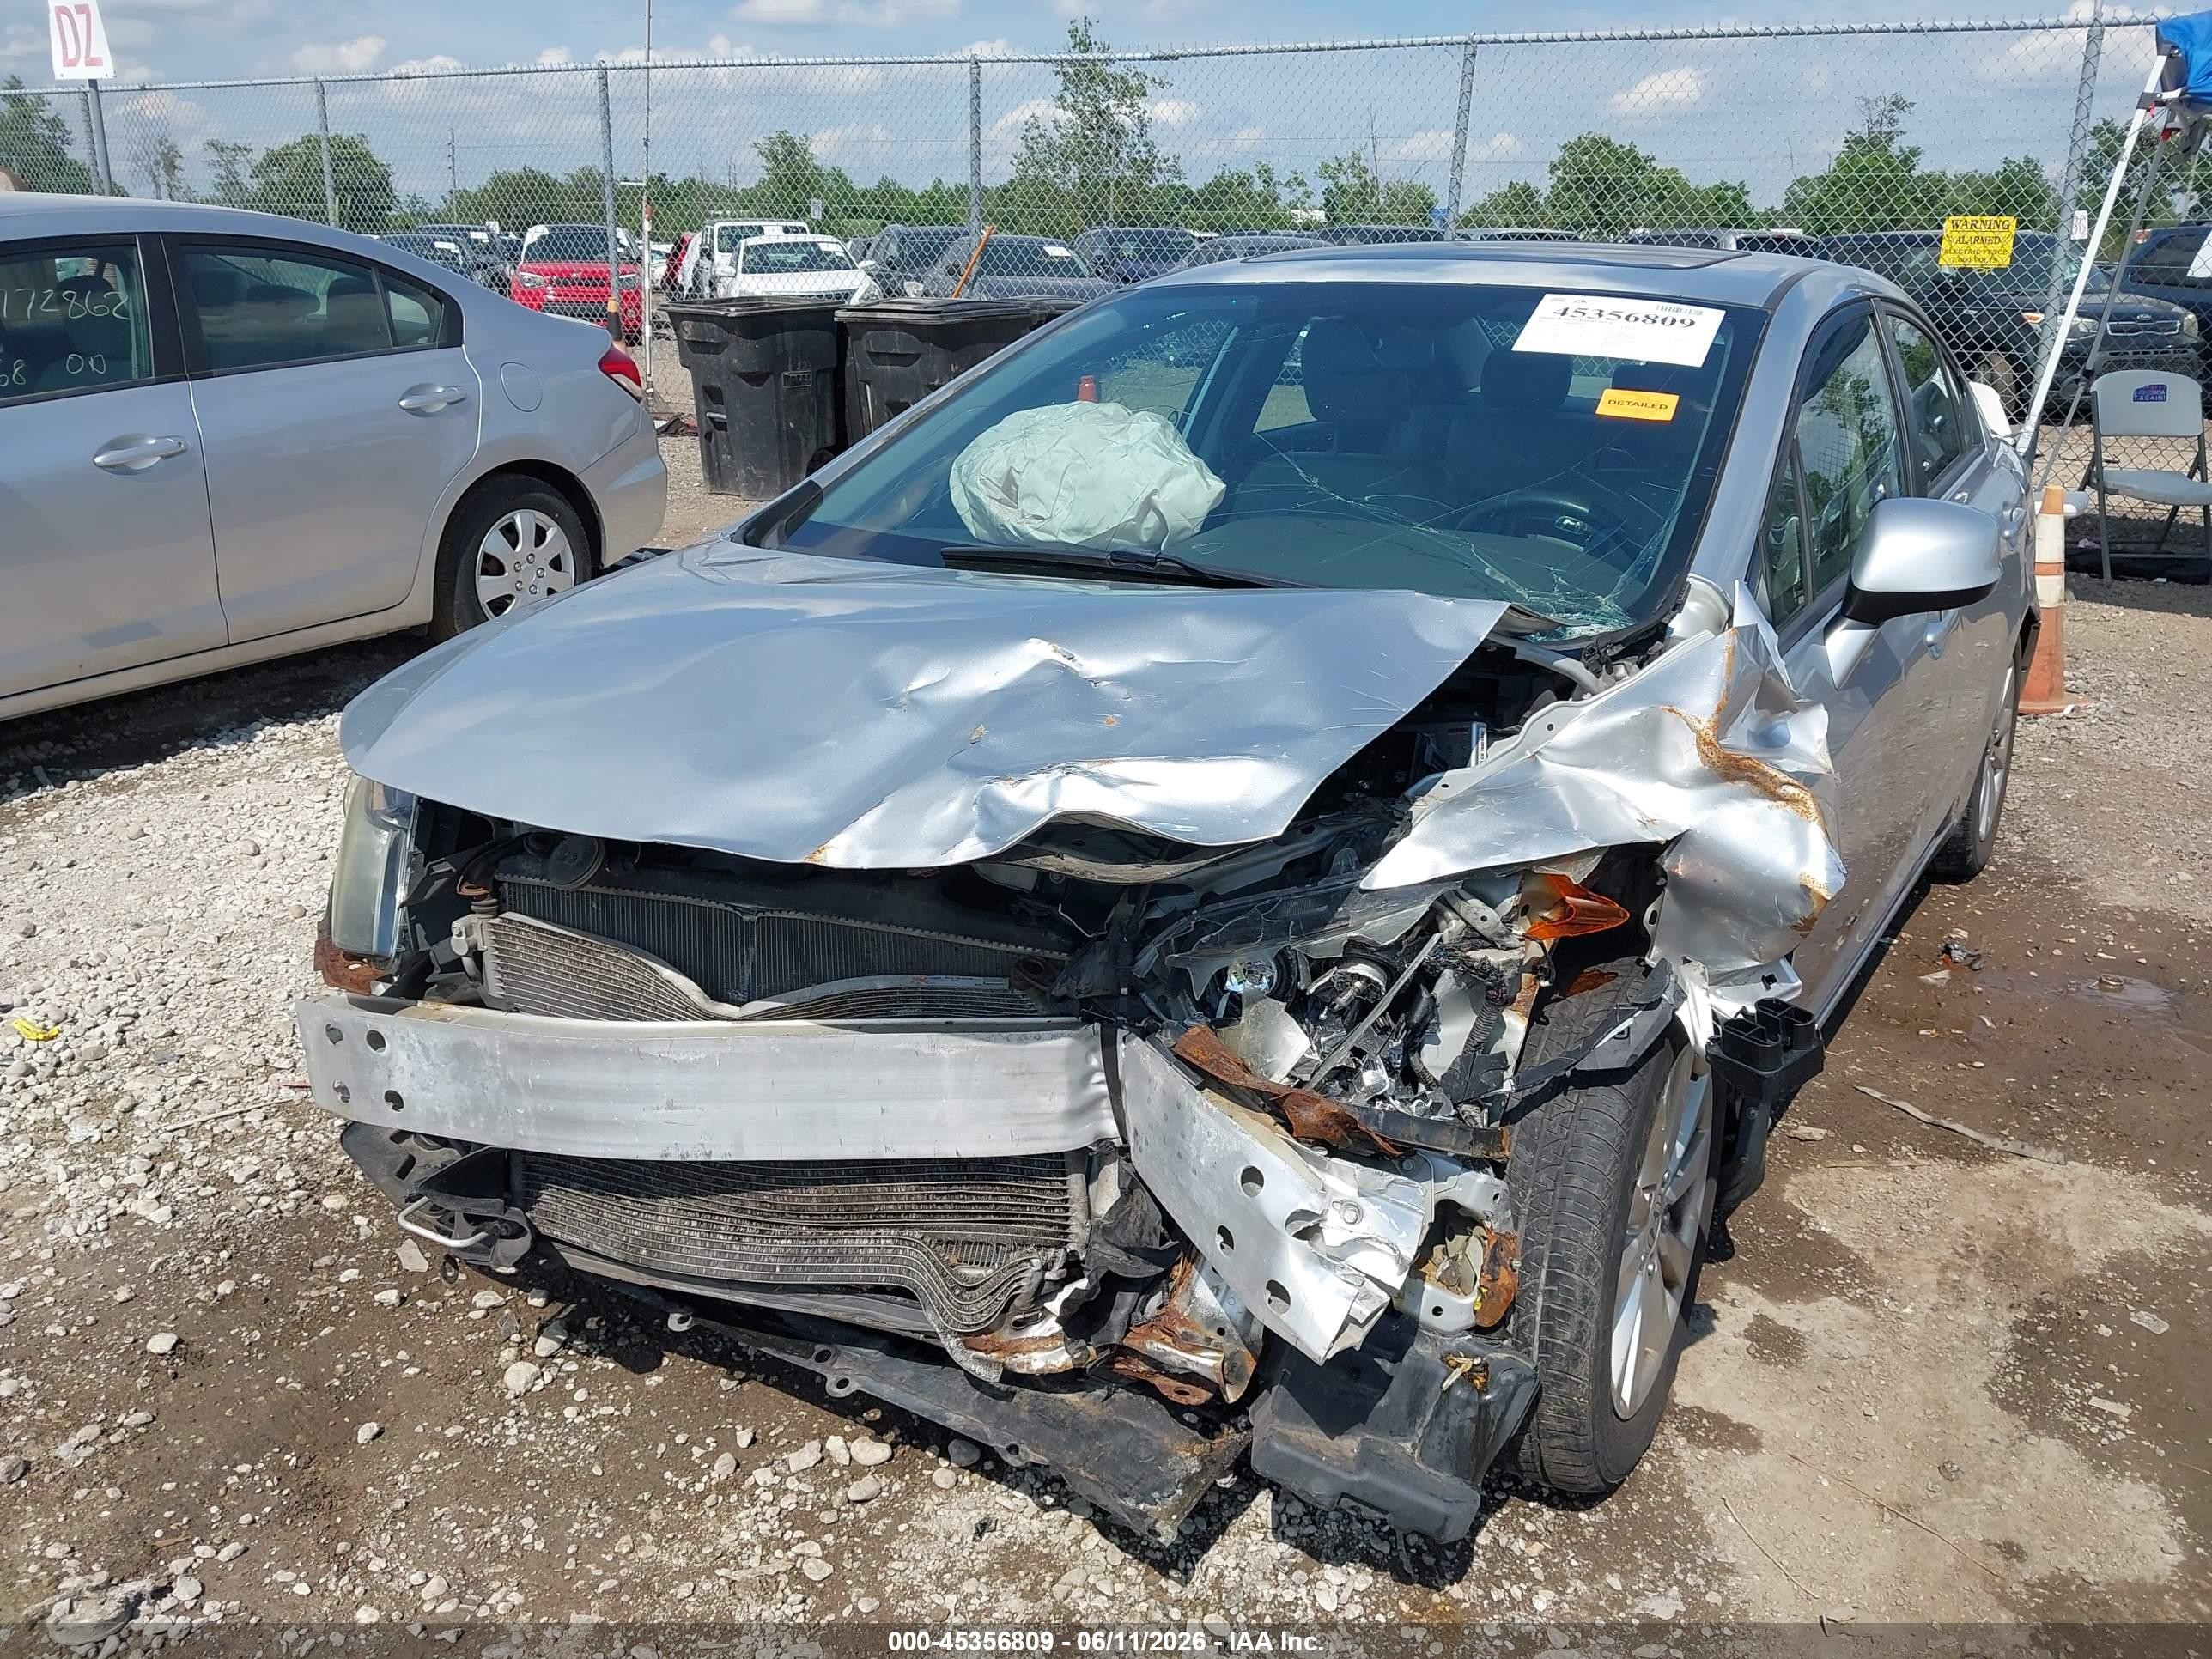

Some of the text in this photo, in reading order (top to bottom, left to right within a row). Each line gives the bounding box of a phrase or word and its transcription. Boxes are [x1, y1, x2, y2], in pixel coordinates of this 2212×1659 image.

[1951, 219, 2010, 230] WARNING
[1955, 235, 2001, 245] ALARMED
[1553, 306, 1696, 328] 45356809
[1607, 399, 1668, 410] DETAILED
